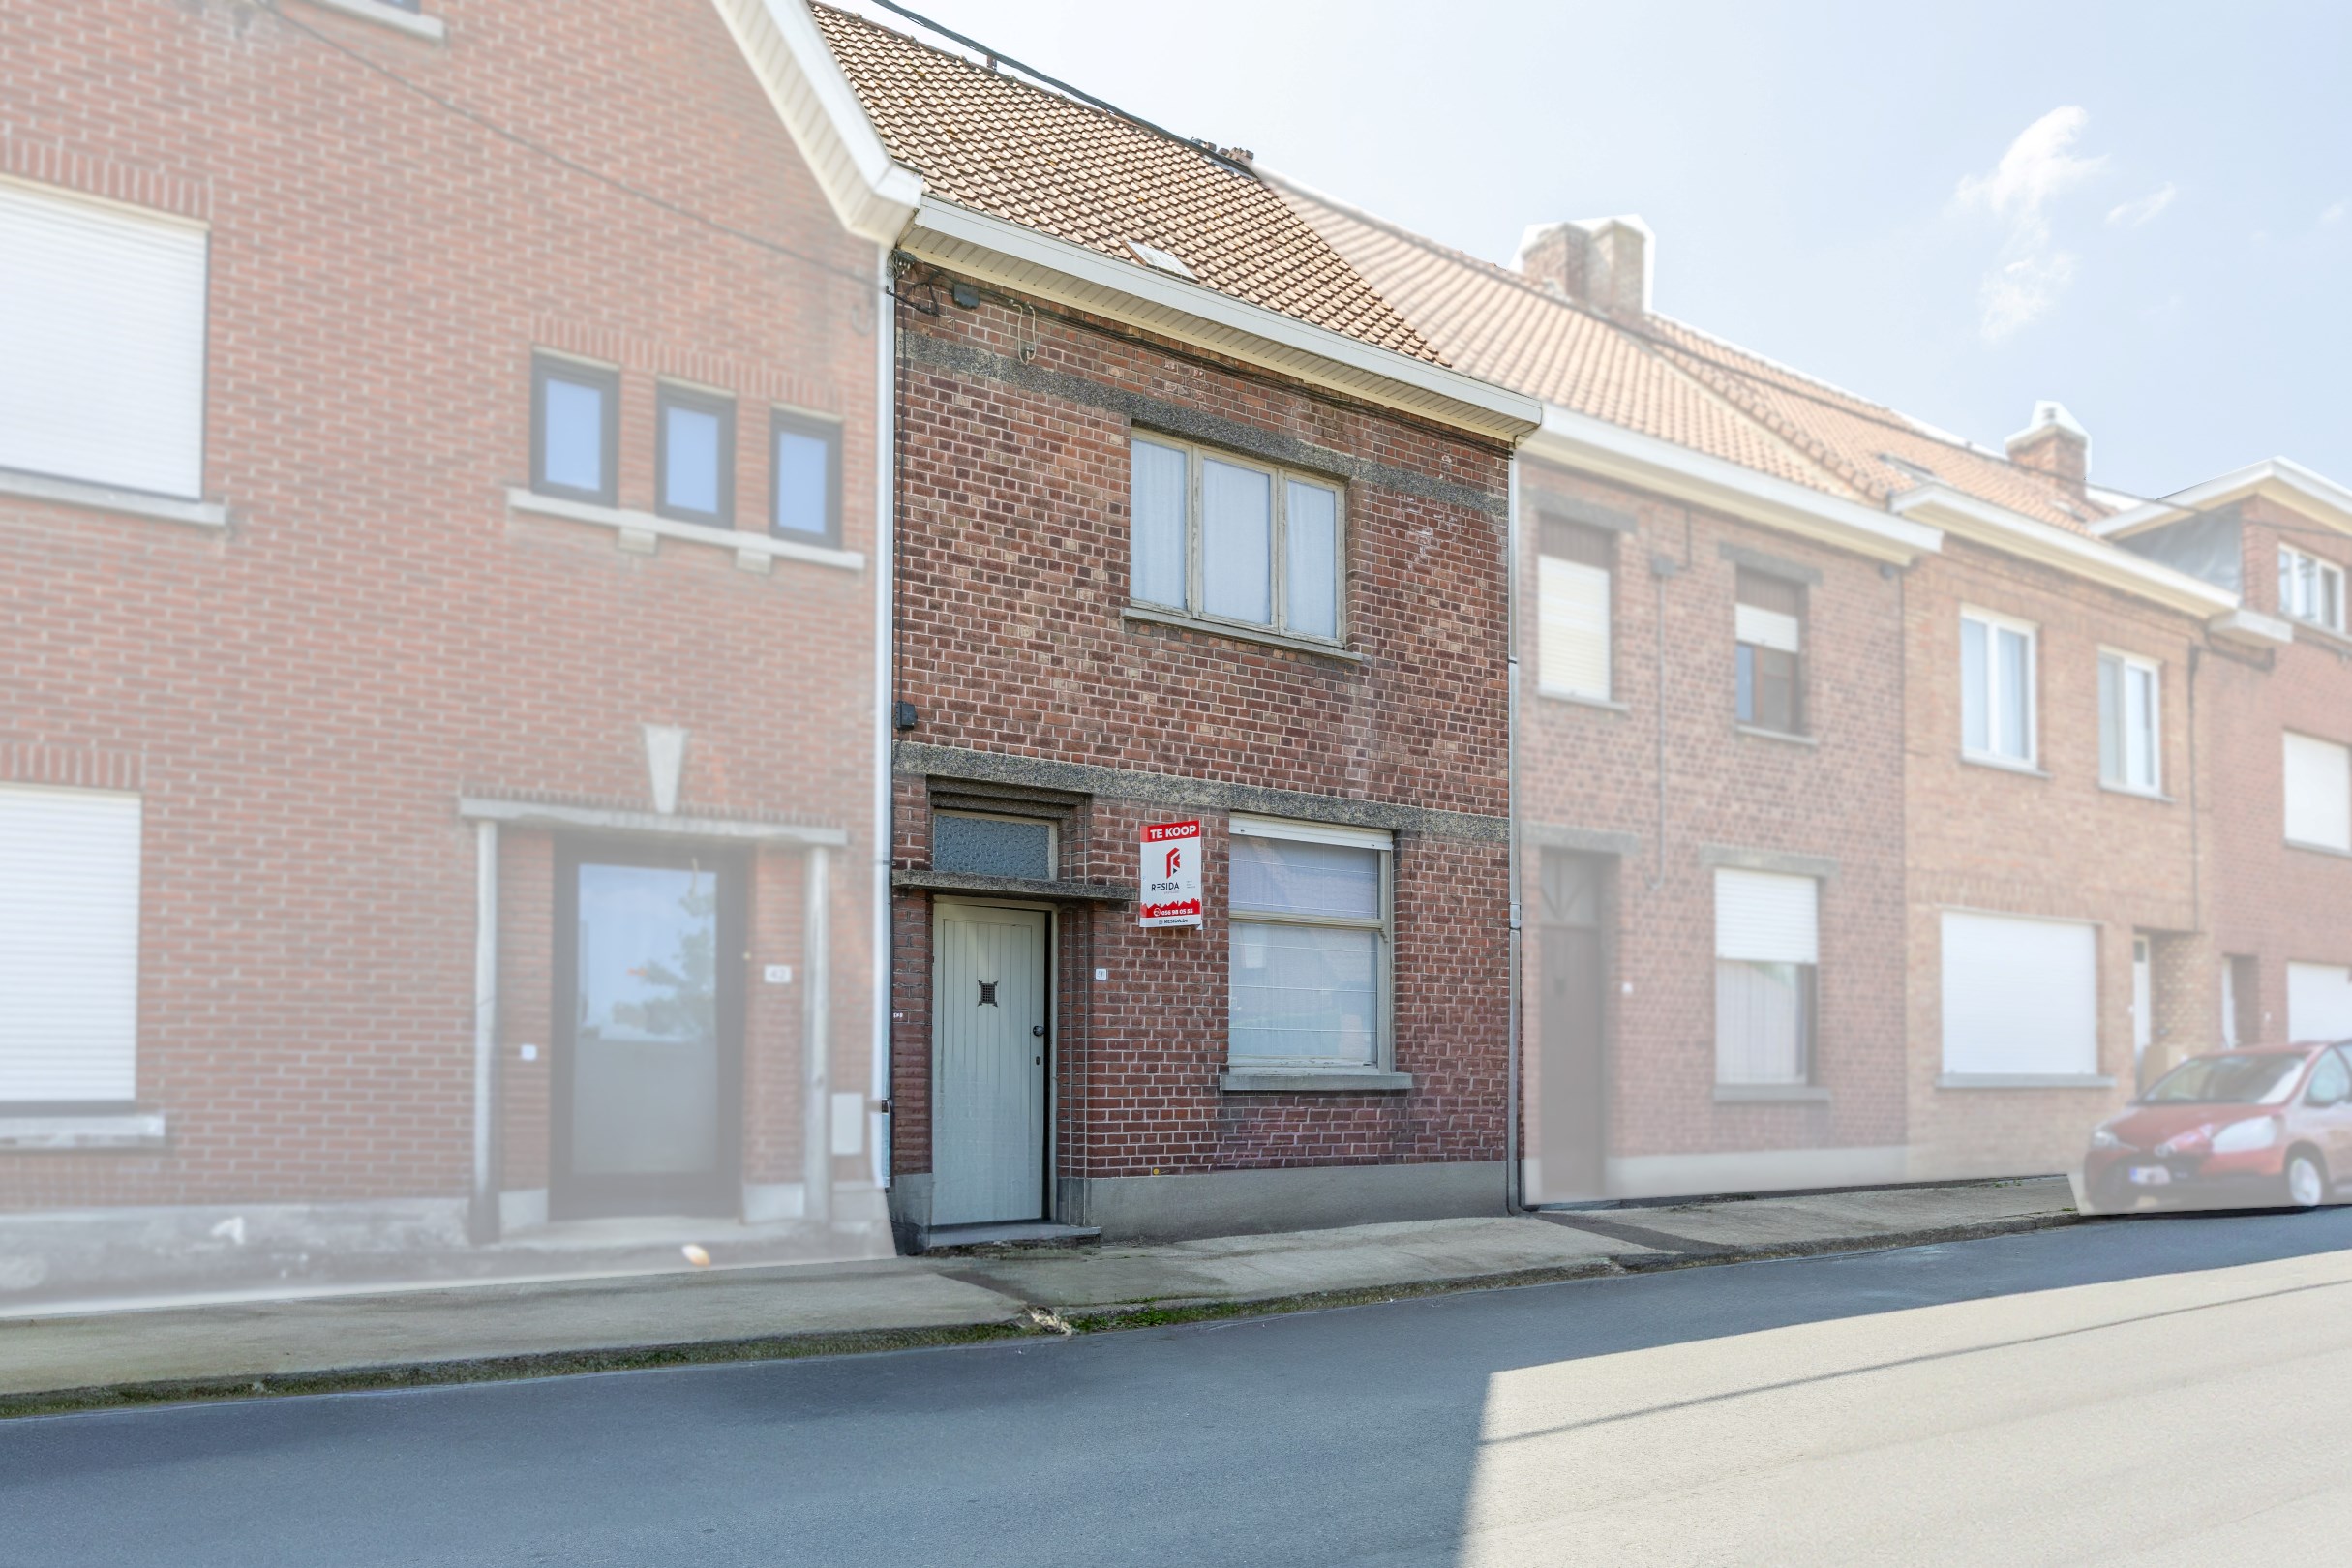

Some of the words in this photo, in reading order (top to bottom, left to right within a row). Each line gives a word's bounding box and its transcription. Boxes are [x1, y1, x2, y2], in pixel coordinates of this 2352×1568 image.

[1150, 829, 1163, 839] TE
[1165, 825, 1196, 838] KOOP
[1152, 882, 1180, 891] RESIDA
